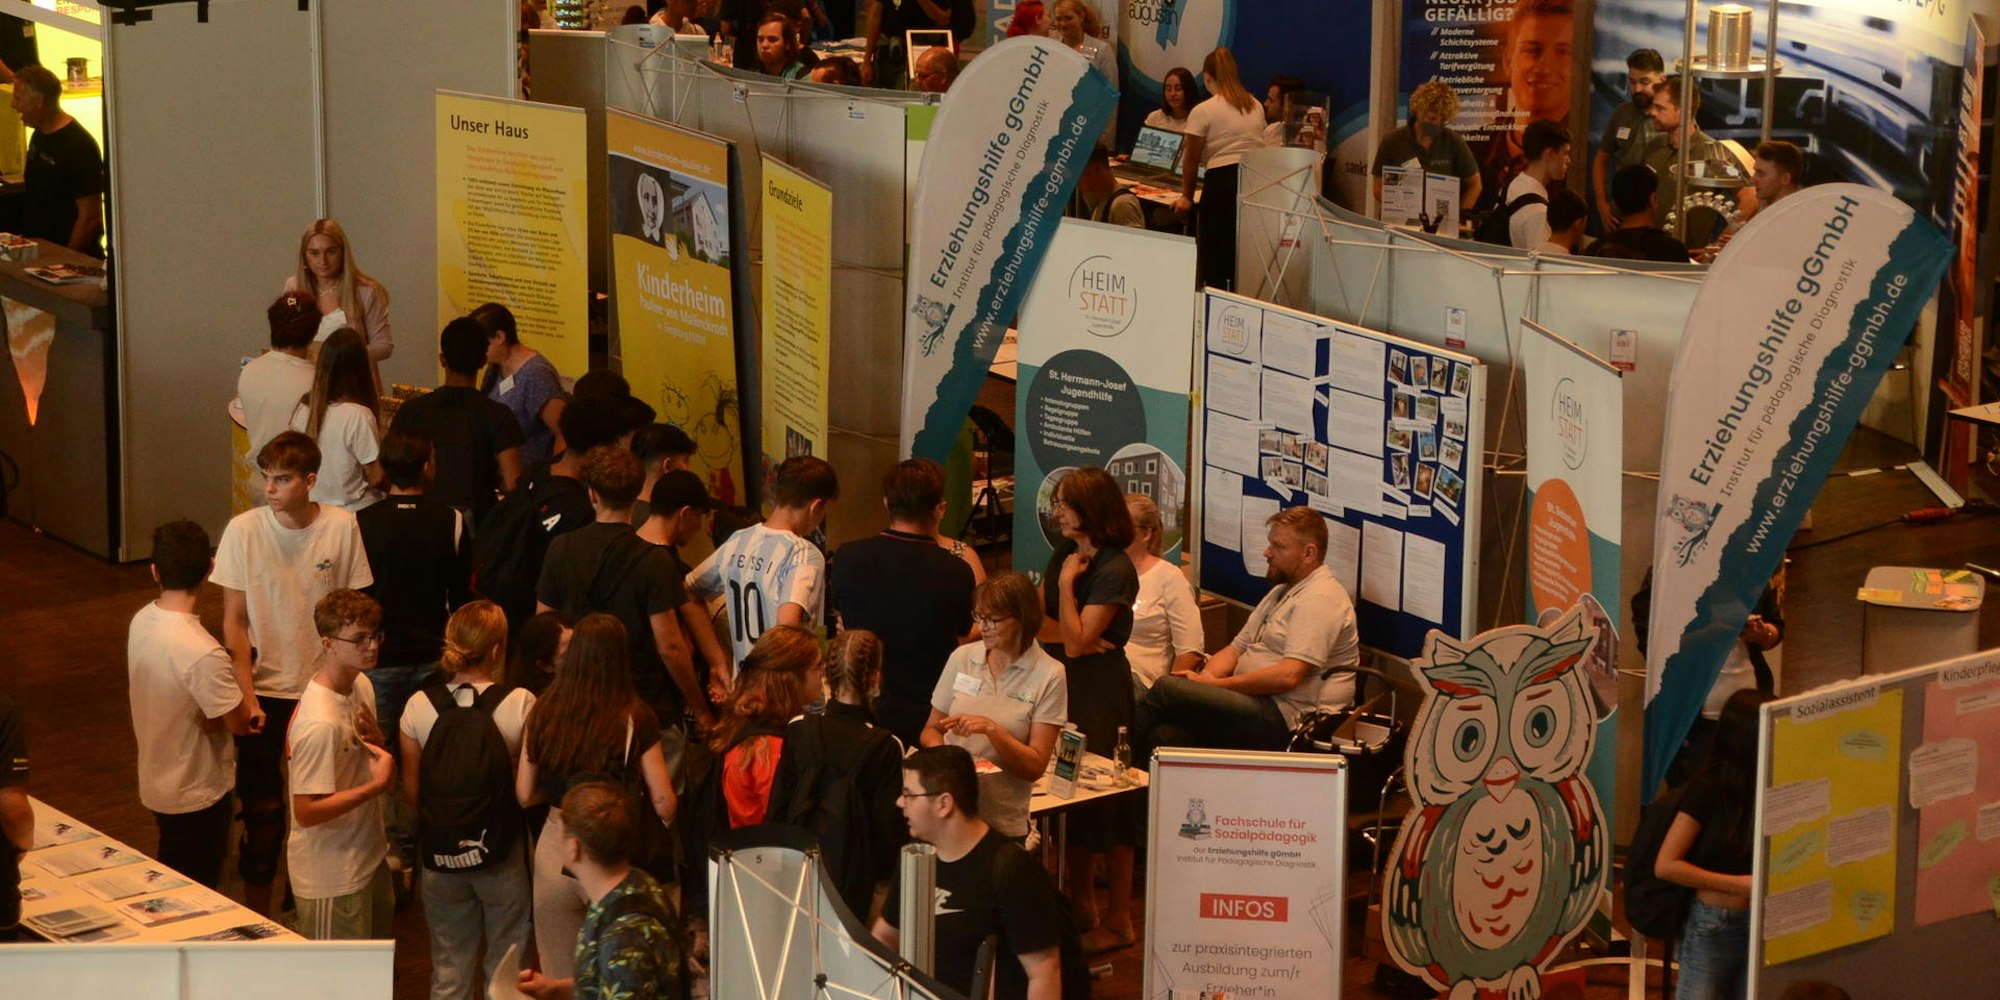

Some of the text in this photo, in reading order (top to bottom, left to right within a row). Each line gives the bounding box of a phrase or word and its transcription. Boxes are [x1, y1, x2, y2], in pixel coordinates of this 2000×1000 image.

[1425, 5, 1514, 22] GEFÄLLIG?
[1440, 39, 1499, 47] Schichtsysteme
[1439, 52, 1479, 60] Attraktive
[1440, 62, 1496, 72] Tarifvergütung
[451, 114, 529, 139] Unser Haus
[930, 46, 1049, 289] Erziehungshilfe gGmbH
[769, 180, 803, 211] Grundziele
[953, 100, 1050, 300] Institut für pädagogische Diagnostik
[973, 114, 1087, 349] www.erziehungshilfe-ggmbh.de
[637, 261, 725, 318] Kinderheim
[1083, 269, 1125, 294] HEIM
[1079, 291, 1128, 317] STATT
[1223, 314, 1245, 330] HEIM
[1689, 195, 1860, 486] Erziehungshilfe gGmbH
[1061, 372, 1127, 391] Hermann-Josef
[1720, 257, 1858, 497] Institut für pädagogische Diagnostik
[1061, 385, 1113, 402] Jugendhilfe
[1559, 392, 1582, 425] HEIM
[1746, 273, 1908, 554] www.erziehungshilfe-ggmbh.de
[1558, 415, 1584, 448] STATT
[730, 579, 765, 644] 10
[1796, 687, 1876, 718] Sozialassistent
[1215, 815, 1306, 829] Fachschule für
[1215, 828, 1317, 845] Sozialpädagogik
[434, 848, 482, 868] PUMA
[1207, 847, 1269, 858] Erziehungshilfe
[1213, 898, 1275, 918] INFOS
[1171, 943, 1312, 960] zur praxisintegrierten
[1182, 962, 1301, 980] Ausbildung zum/r
